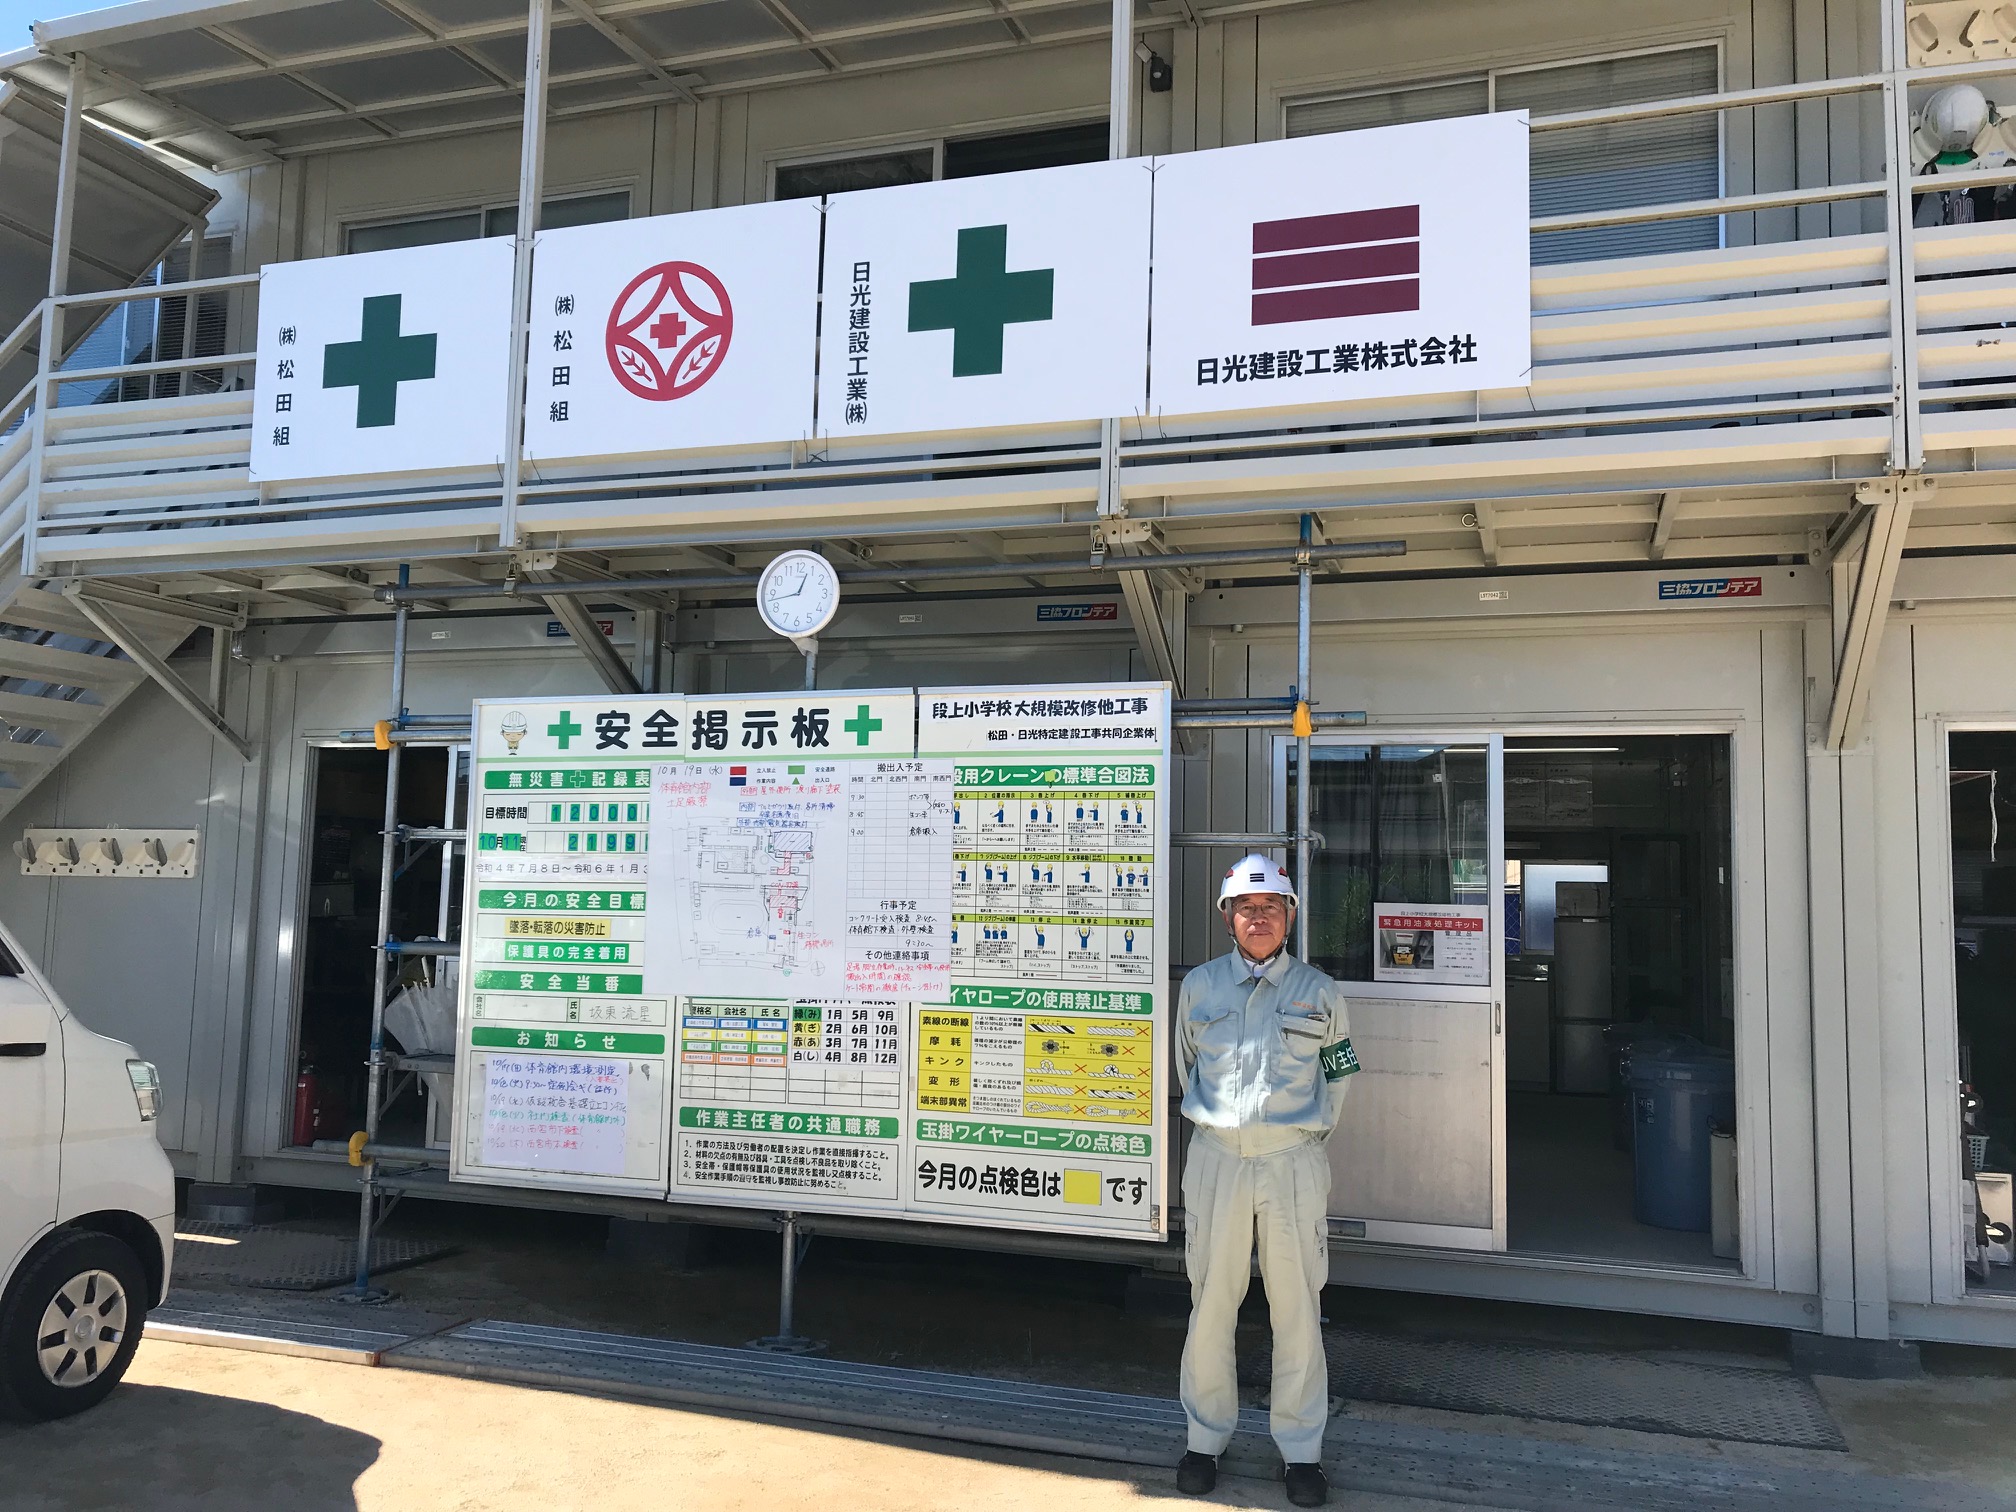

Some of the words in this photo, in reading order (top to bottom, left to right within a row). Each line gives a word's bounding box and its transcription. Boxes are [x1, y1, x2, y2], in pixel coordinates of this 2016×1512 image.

[1196, 333, 1478, 387] 日光建設工業株式会社
[785, 565, 793, 576] 11
[796, 562, 806, 573] 12
[811, 565, 815, 576] 1
[774, 575, 783, 586] 10
[818, 574, 825, 585] 2
[770, 588, 776, 600] 9
[821, 588, 828, 600] 3
[1661, 581, 1759, 597] 三協フロンテア
[773, 602, 780, 613] 8
[816, 602, 822, 612] 4
[1038, 605, 1116, 619] 三協フロンテア
[783, 612, 789, 623] 7
[793, 616, 800, 627] 6
[806, 612, 813, 624] 5
[595, 707, 830, 750] 安全掲示板
[987, 727, 1155, 741] 松田・日光特定建設工事共同企業体
[877, 762, 924, 773] 搬出入予定
[889, 775, 908, 783] 北西門
[485, 806, 528, 819] 目標時間
[503, 892, 646, 909] 今月の安全目標
[880, 900, 917, 911] 行事予定
[509, 920, 606, 936] 墜落・転落の災害防止
[507, 944, 626, 960] 保護具の完全着用
[865, 950, 930, 962] その他連絡事項
[520, 974, 619, 992] 安全当番
[569, 1001, 578, 1020] 氏名
[723, 1006, 747, 1016] 会社名
[760, 1008, 781, 1018] 氏名
[827, 1010, 842, 1020] 1月
[852, 1010, 868, 1020] 5月
[877, 1011, 894, 1021] 9月
[922, 1016, 970, 1027] 素線の断線
[826, 1023, 842, 1034] 2月
[851, 1024, 868, 1035] 6月
[875, 1025, 898, 1035] 10月
[517, 1031, 616, 1050] お知らせ
[826, 1038, 842, 1048] 3月
[851, 1038, 868, 1049] 7月
[875, 1039, 898, 1050] 11月
[929, 1036, 961, 1047] 摩耗
[825, 1051, 842, 1062] 4月
[851, 1052, 867, 1063] 8月
[874, 1053, 897, 1064] 12月
[925, 1056, 964, 1066] キンク
[928, 1076, 960, 1087] 変形
[920, 1096, 967, 1107] 端末部異常
[696, 1109, 881, 1136] 作業主任者の共通職務
[922, 1122, 1146, 1154] 玉掛ワイヤーロープの点検色
[918, 1160, 1061, 1198] 今月の点検色は
[1106, 1177, 1148, 1205] です
